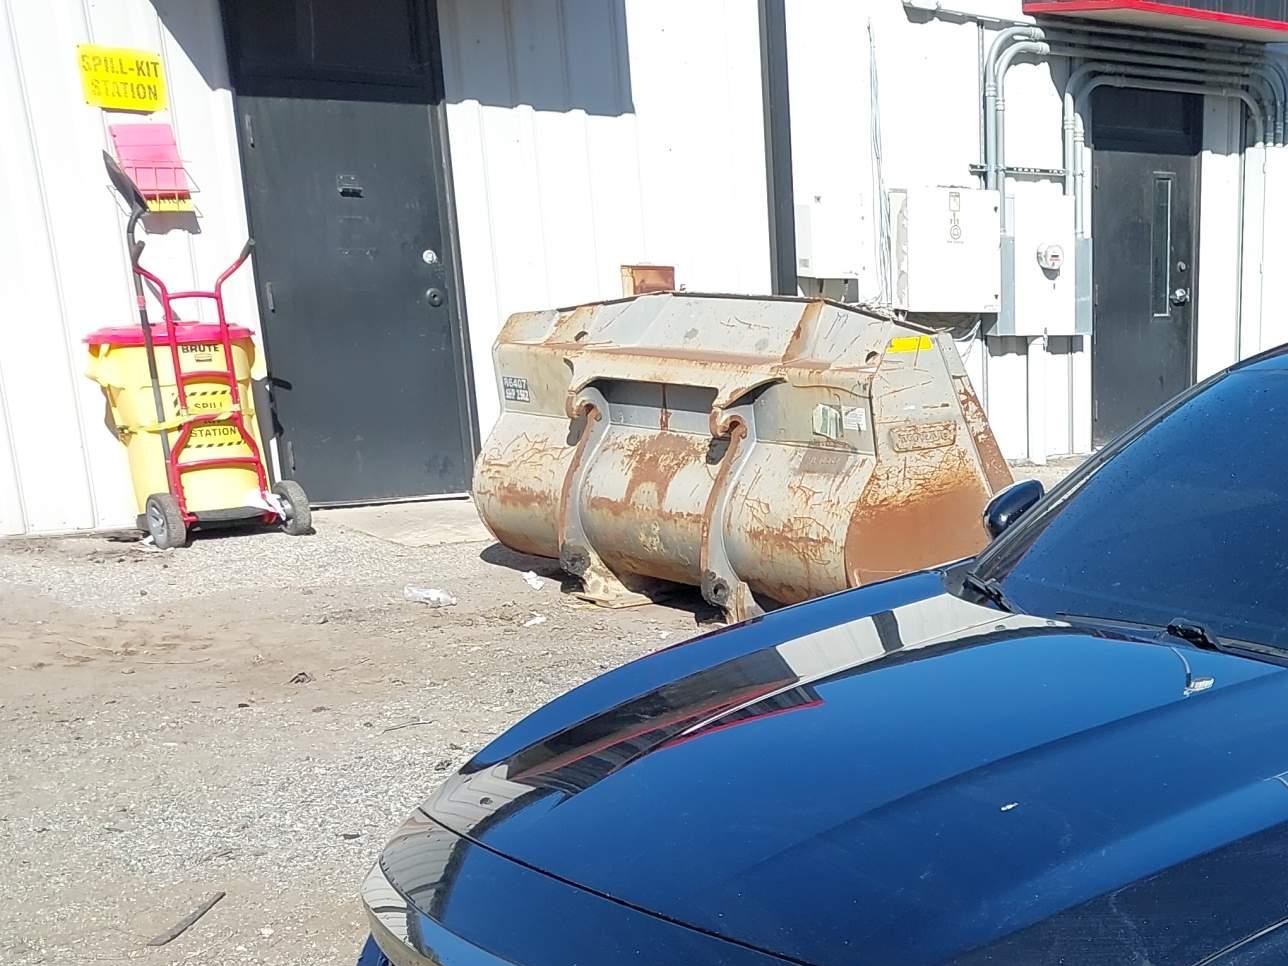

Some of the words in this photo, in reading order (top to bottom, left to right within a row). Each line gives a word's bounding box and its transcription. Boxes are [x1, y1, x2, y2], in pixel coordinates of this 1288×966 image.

[81, 54, 160, 78] SPILL-KIT
[91, 79, 158, 101] STATION
[182, 344, 219, 353] BRUTE
[191, 427, 236, 438] STATION
